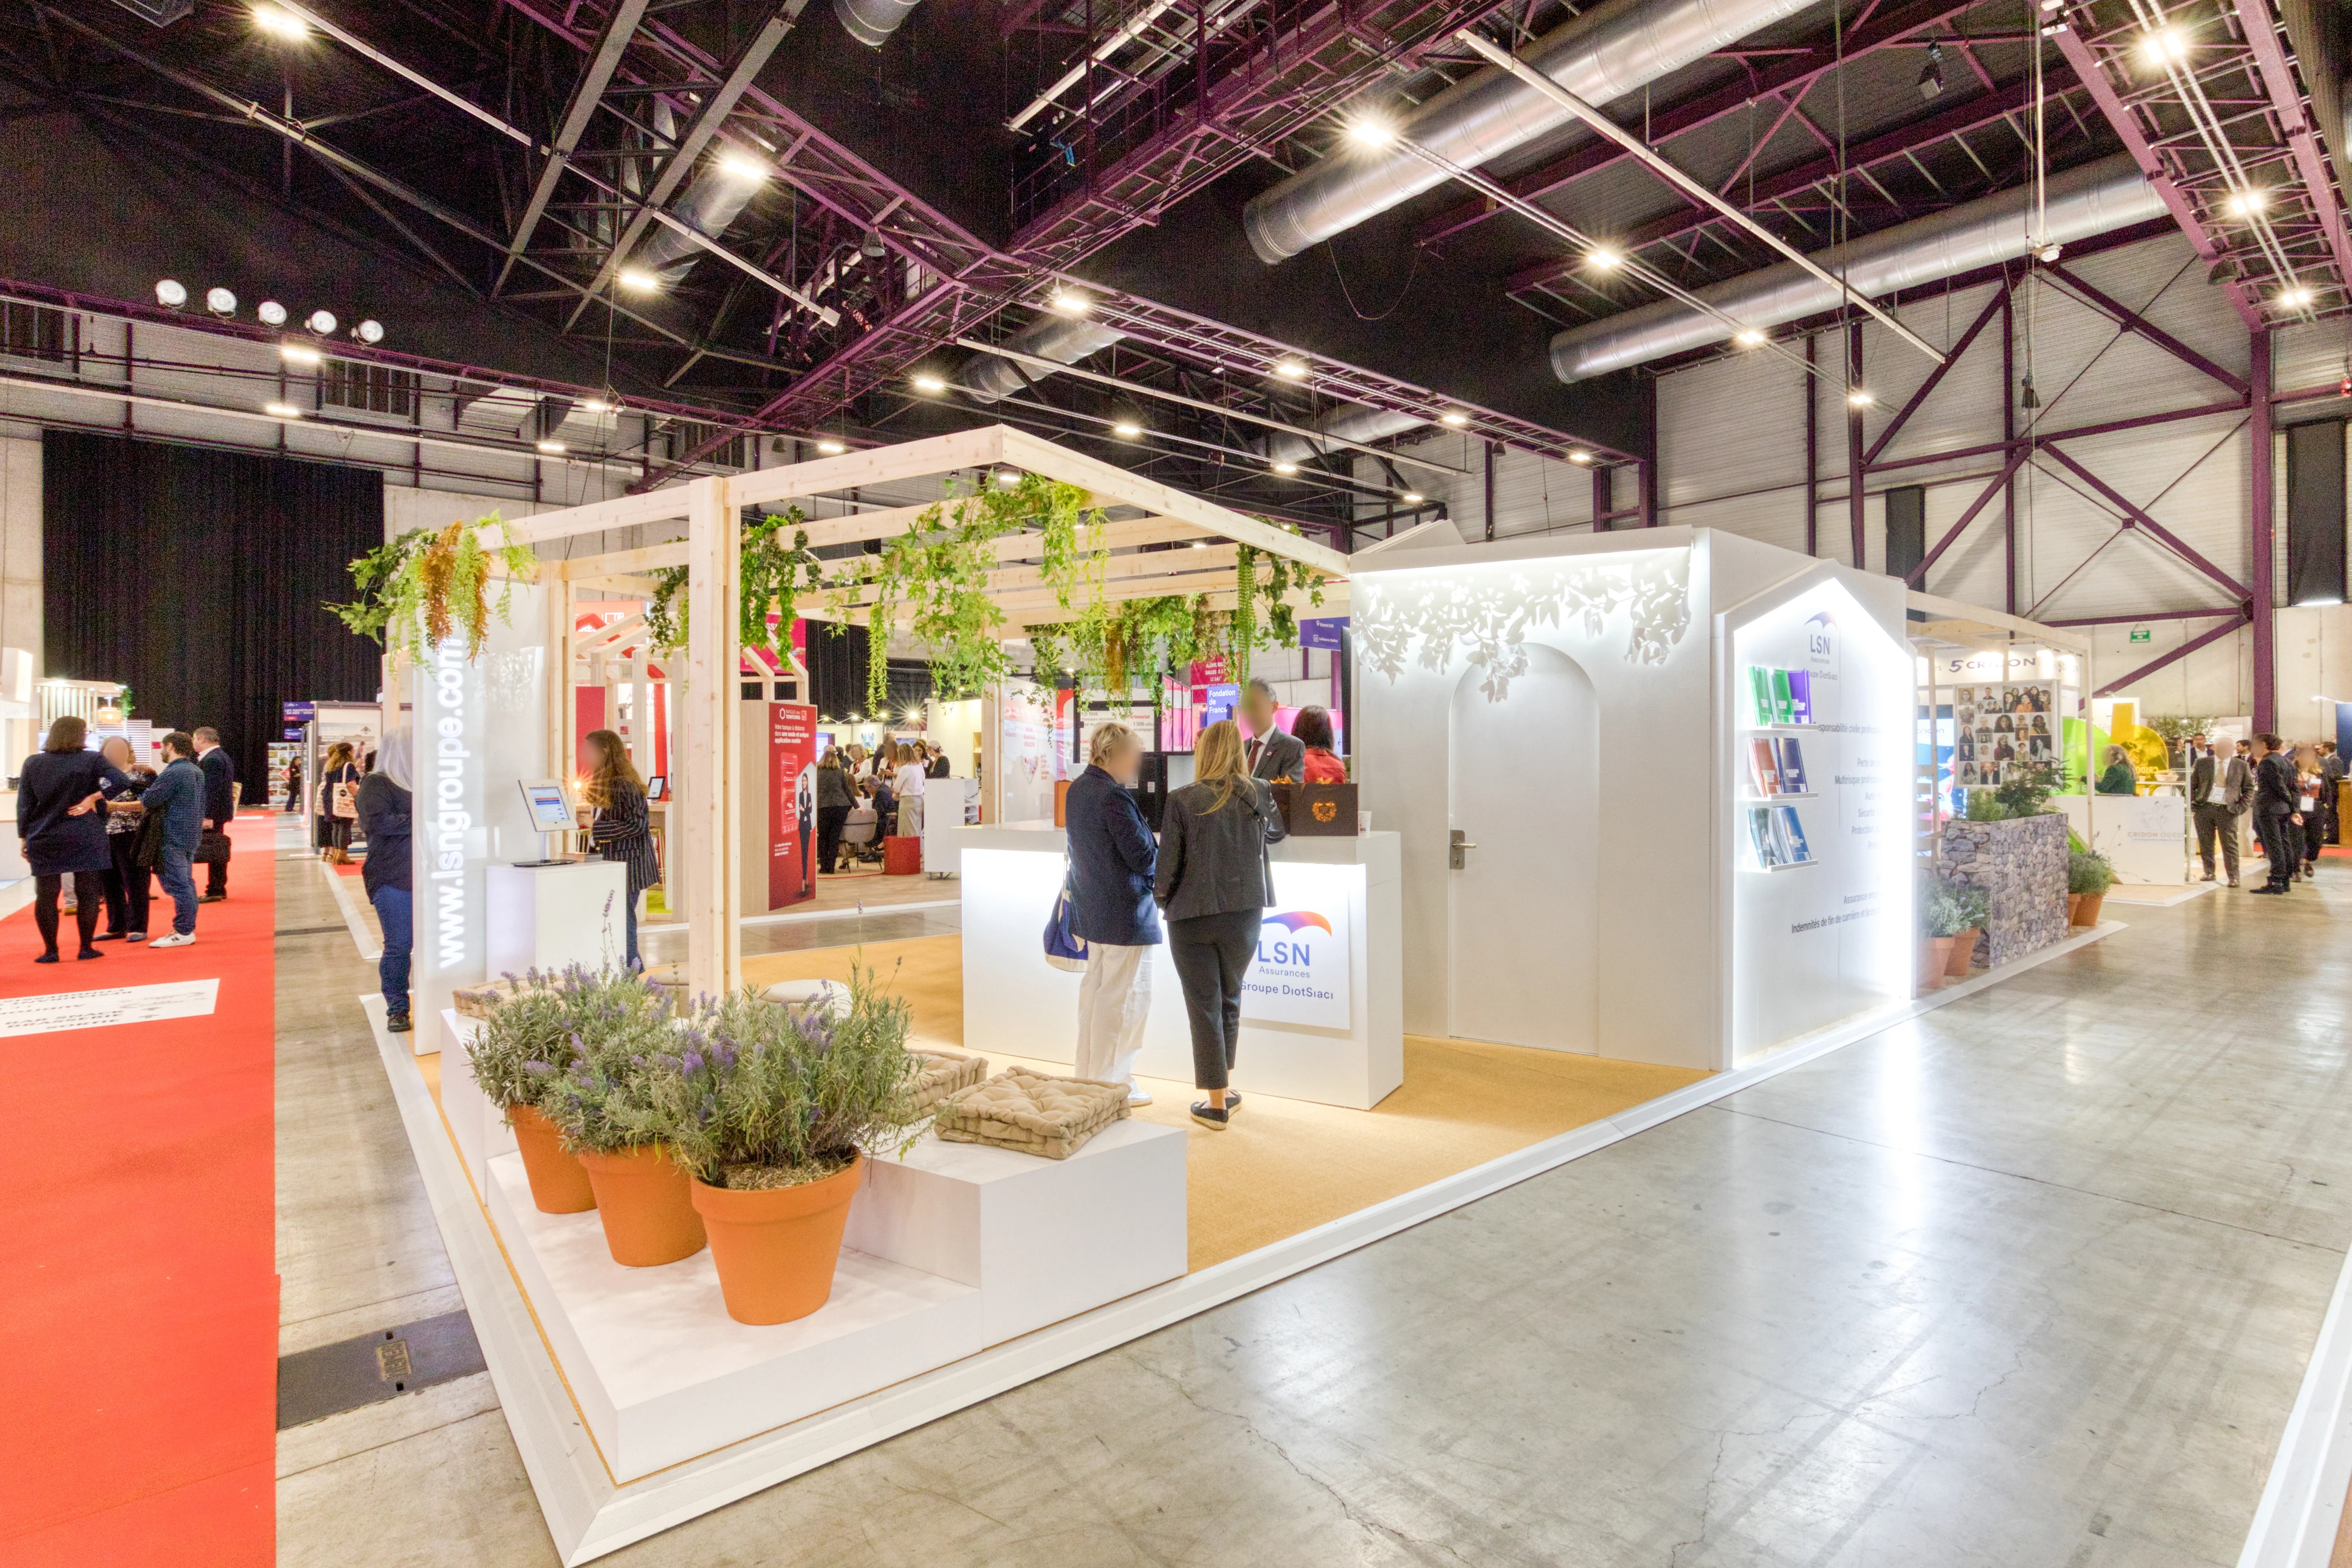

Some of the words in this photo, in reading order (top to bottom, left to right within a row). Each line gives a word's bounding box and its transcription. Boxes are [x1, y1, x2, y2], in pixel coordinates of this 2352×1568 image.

[1810, 634, 1830, 655] LSN
[1811, 656, 1830, 664] Assurances
[1948, 660, 1964, 673] 5
[1813, 722, 1848, 734] sponsabilité
[1849, 724, 1860, 733] civile
[1857, 758, 1869, 767] Perte
[1835, 775, 1860, 786] Multirisque
[431, 638, 471, 969] www.lsngroupe.com
[1843, 892, 1867, 905] Assurance
[1791, 918, 1820, 933] Indemnités
[1821, 917, 1827, 927] de
[1836, 914, 1842, 923] de
[1842, 910, 1859, 923] carrière
[1258, 941, 1310, 966] LSN
[1259, 966, 1310, 978] Assurances
[1241, 980, 1278, 995] Groupe
